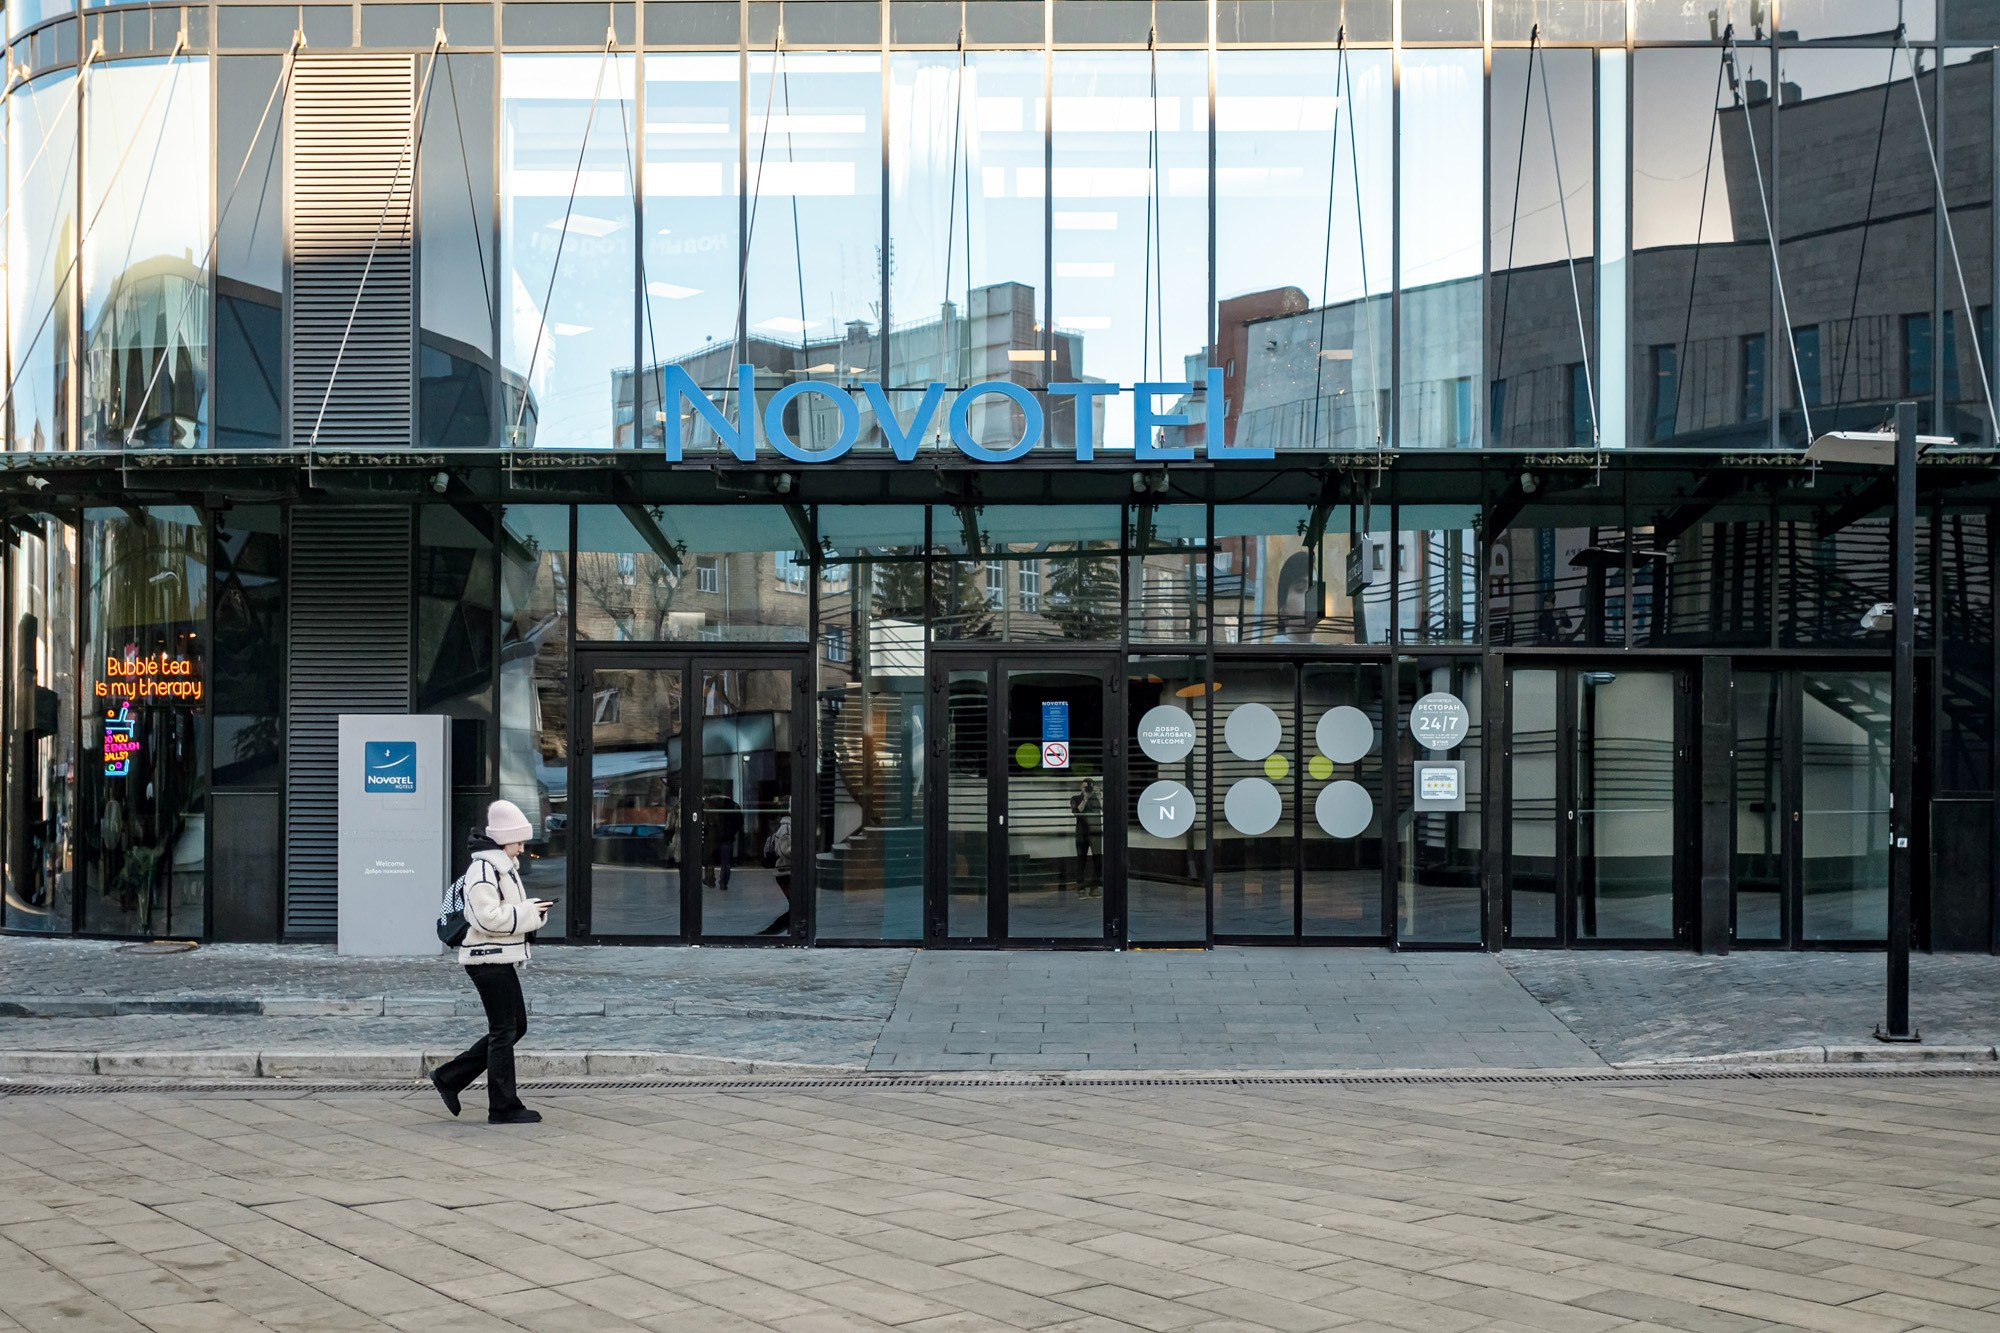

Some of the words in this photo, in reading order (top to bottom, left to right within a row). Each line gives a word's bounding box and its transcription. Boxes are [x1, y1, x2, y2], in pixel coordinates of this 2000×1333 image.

[665, 364, 1275, 463] NOVOTEL
[107, 656, 158, 676] Bubble
[161, 660, 190, 675] tea
[95, 680, 107, 696] is
[111, 681, 136, 701] my
[139, 678, 202, 700] therapy
[1420, 716, 1459, 732] 24/7
[113, 733, 128, 743] YOU
[1159, 805, 1175, 820] N
